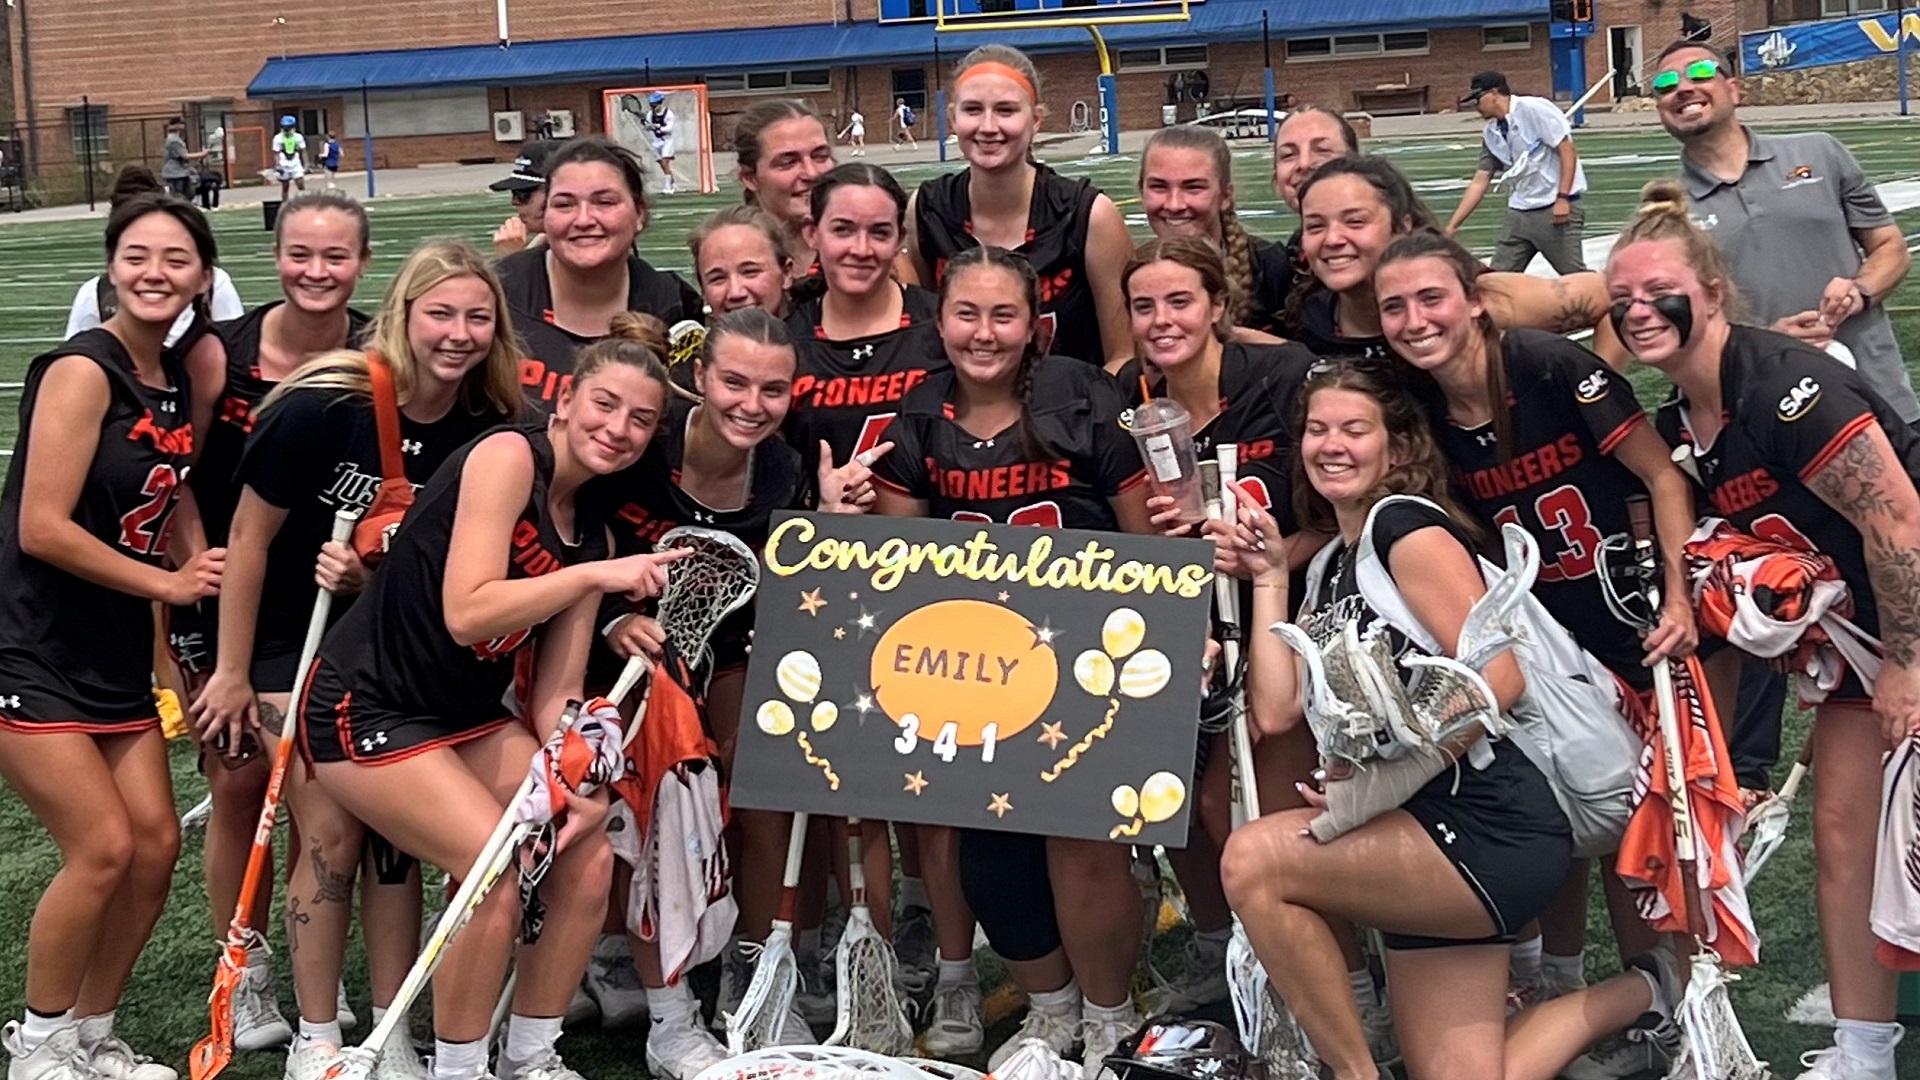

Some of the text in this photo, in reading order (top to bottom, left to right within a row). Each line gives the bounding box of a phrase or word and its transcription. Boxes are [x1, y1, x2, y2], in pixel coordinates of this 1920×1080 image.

[1577, 370, 1609, 398] SAC
[1778, 376, 1820, 416] SAC
[763, 517, 1215, 598] Congratulations
[893, 644, 1019, 686] EMILY
